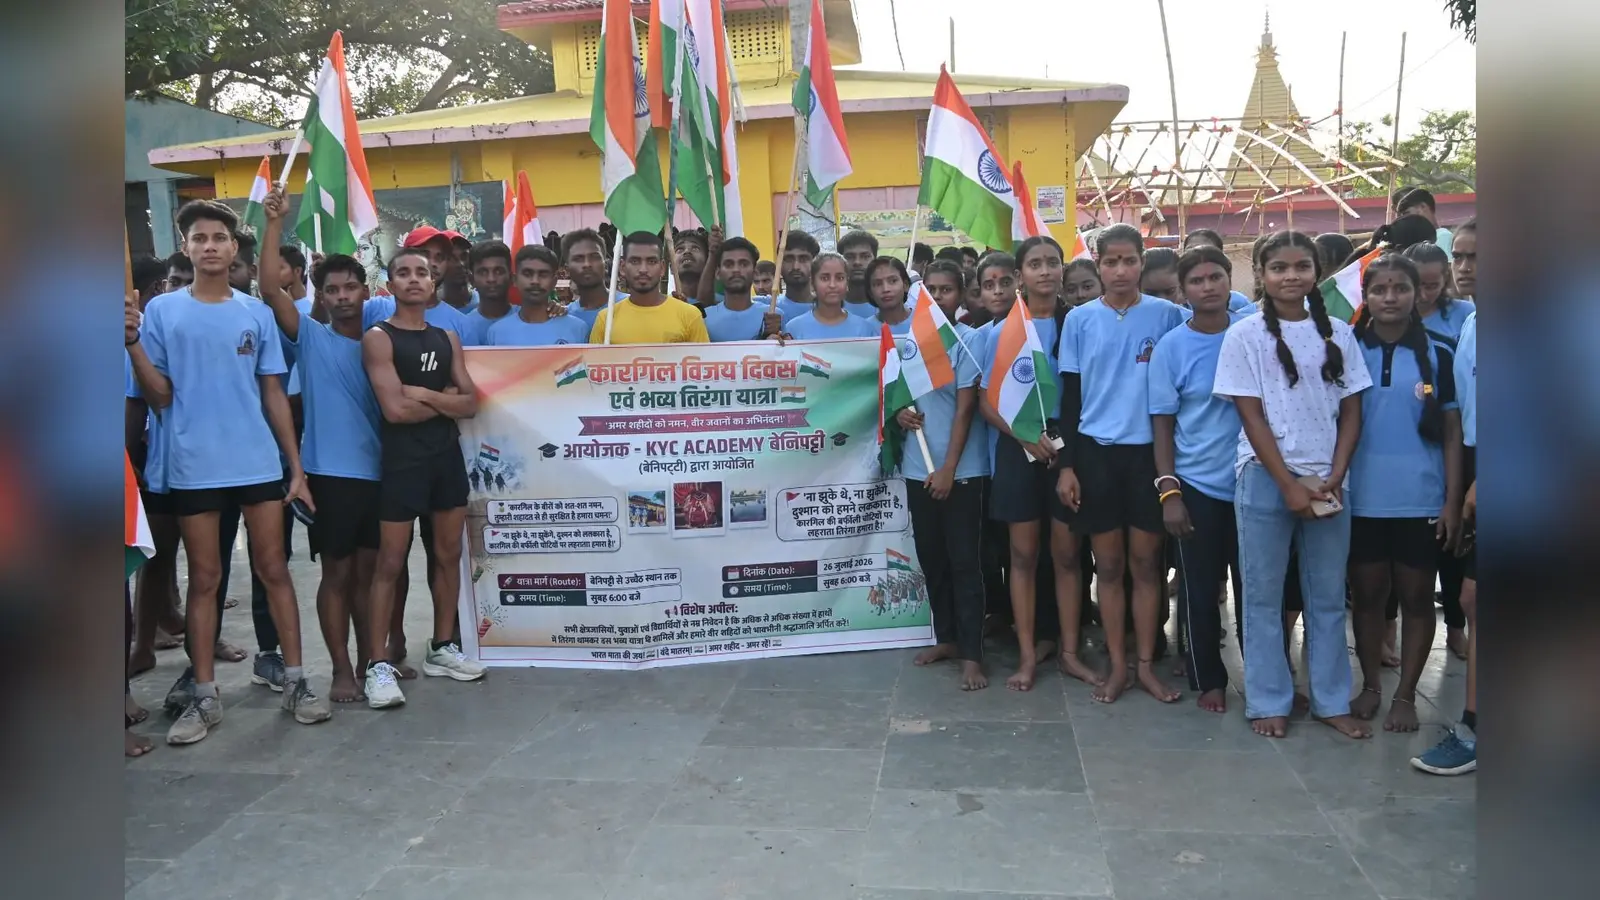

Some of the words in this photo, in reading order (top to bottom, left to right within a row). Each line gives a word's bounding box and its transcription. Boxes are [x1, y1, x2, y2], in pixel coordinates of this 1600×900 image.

[587, 357, 677, 382] कारगिल
[680, 355, 737, 381] विजय
[741, 355, 798, 380] दिवस
[609, 386, 635, 410] एवं
[639, 391, 677, 408] भव्य
[680, 385, 732, 407] तिरंगा
[736, 387, 778, 406] यात्रा
[605, 421, 627, 430] 'अमर
[629, 418, 653, 430] शहीदों
[655, 418, 666, 428] को
[668, 420, 689, 429] नमन,
[691, 416, 703, 427] वीर
[706, 415, 732, 426] जवानों
[733, 417, 743, 425] का
[746, 414, 785, 425] अभिनंदन!'
[564, 438, 630, 458] आयोजक
[646, 440, 679, 456] KYC
[683, 437, 765, 455] ACADEMY
[768, 430, 826, 453] बेनिपट्टी
[690, 461, 709, 473] द्वारा
[712, 457, 754, 470] आयोजित
[818, 488, 837, 503] झुके
[840, 488, 851, 501] थे,
[853, 490, 863, 499] ना
[534, 501, 540, 510] के
[822, 504, 833, 515] को
[836, 501, 856, 515] हमने
[494, 512, 512, 523] तुम्हारी
[534, 511, 540, 520] से
[541, 511, 548, 521] ही
[549, 511, 570, 522] सुरक्षित
[571, 510, 576, 520] है
[577, 512, 593, 520] हमारा
[796, 516, 825, 527] कारगिल
[827, 515, 836, 525] की
[884, 511, 893, 519] पर
[807, 529, 834, 538] लहराता
[836, 525, 856, 536] तिरंगा
[857, 523, 874, 534] हमारा
[488, 541, 511, 549] कारगिल
[512, 541, 519, 549] की
[743, 566, 766, 577] दिनांक
[767, 567, 795, 577] (Date):
[824, 563, 833, 571] 26
[834, 559, 853, 571] जुलाई
[854, 558, 873, 567] 2026
[517, 578, 533, 586] यात्रा
[534, 576, 548, 586] मार्ग
[549, 577, 581, 588] (Route):
[589, 574, 615, 586] बेनिपट्टी
[616, 575, 624, 584] से
[645, 573, 663, 583] स्थान
[823, 578, 839, 589] सुबह
[840, 577, 857, 585] 6:00
[859, 573, 871, 583] बजे
[744, 584, 762, 593] समय
[763, 583, 792, 593] (Time):
[538, 594, 566, 604] (Time):
[590, 594, 607, 605] सुबह
[609, 594, 627, 602] 6:00
[628, 591, 641, 601] बजे
[680, 603, 705, 616] विशेष
[708, 601, 738, 615] अपील:
[564, 624, 578, 633] सभी
[682, 618, 689, 628] से
[702, 617, 723, 627] निवेदन
[724, 616, 729, 626] है
[731, 615, 740, 624] कि
[742, 614, 762, 623] अधिक
[763, 613, 769, 622] से
[771, 612, 791, 622] अधिक
[792, 610, 810, 620] संख्या
[818, 607, 832, 617] हाथों
[558, 635, 575, 644] तिरंगा
[613, 637, 627, 645] भव्य
[629, 637, 643, 645] यात्रा
[676, 630, 688, 640] और
[690, 629, 705, 639] हमारे
[707, 628, 718, 637] वीर
[742, 625, 751, 635] को
[816, 618, 834, 629] अर्पित
[591, 651, 607, 659] भारत
[622, 650, 630, 659] की
[724, 641, 740, 651] शहीद
[746, 641, 759, 649] अमर
